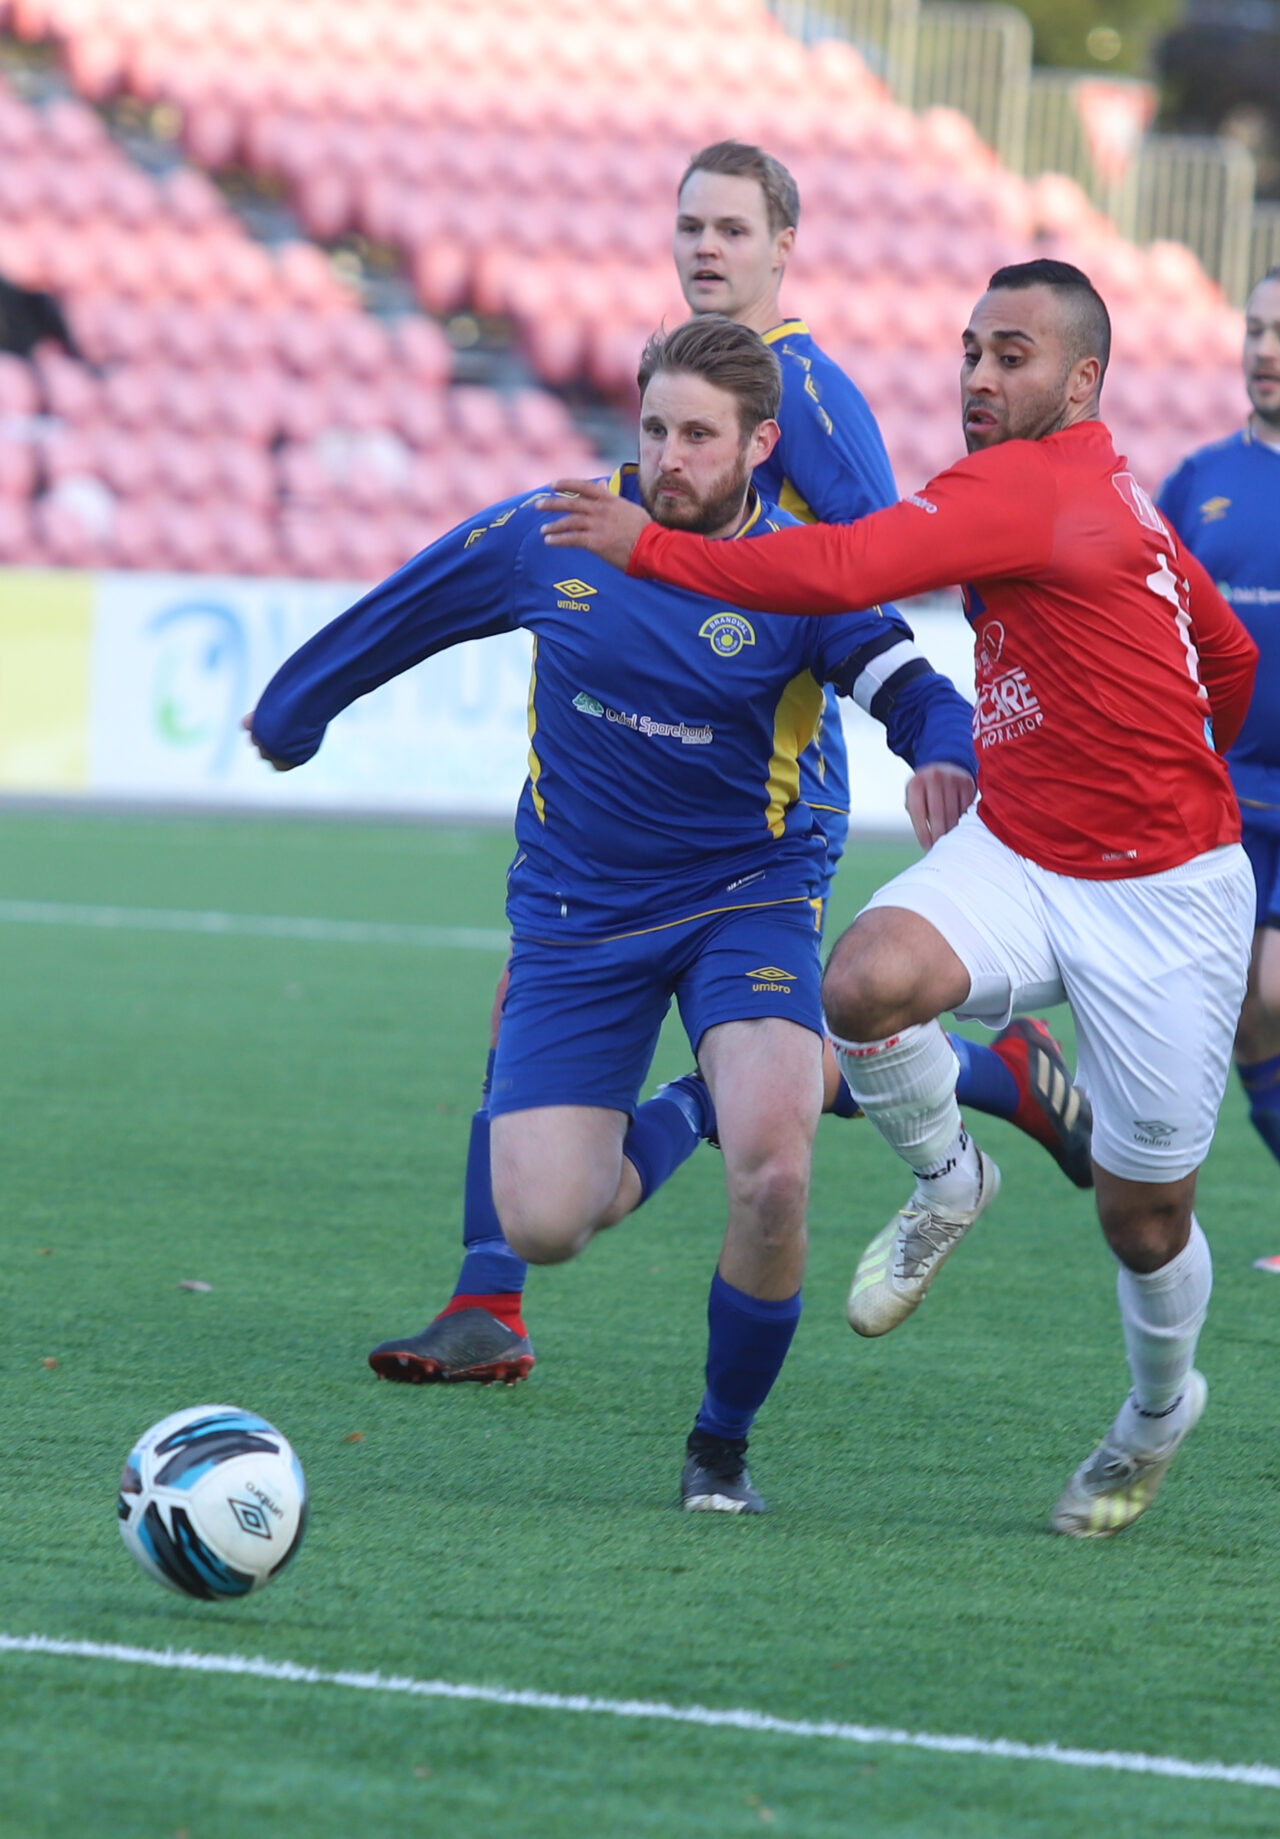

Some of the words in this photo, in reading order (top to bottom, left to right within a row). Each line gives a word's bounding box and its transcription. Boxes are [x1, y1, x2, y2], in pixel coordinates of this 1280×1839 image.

[556, 599, 591, 612] umbro
[605, 707, 638, 731] Odal
[638, 716, 713, 740] Sparebank
[752, 982, 792, 995] umbro
[1133, 1133, 1172, 1147] umbro
[245, 1480, 284, 1521] umbro
